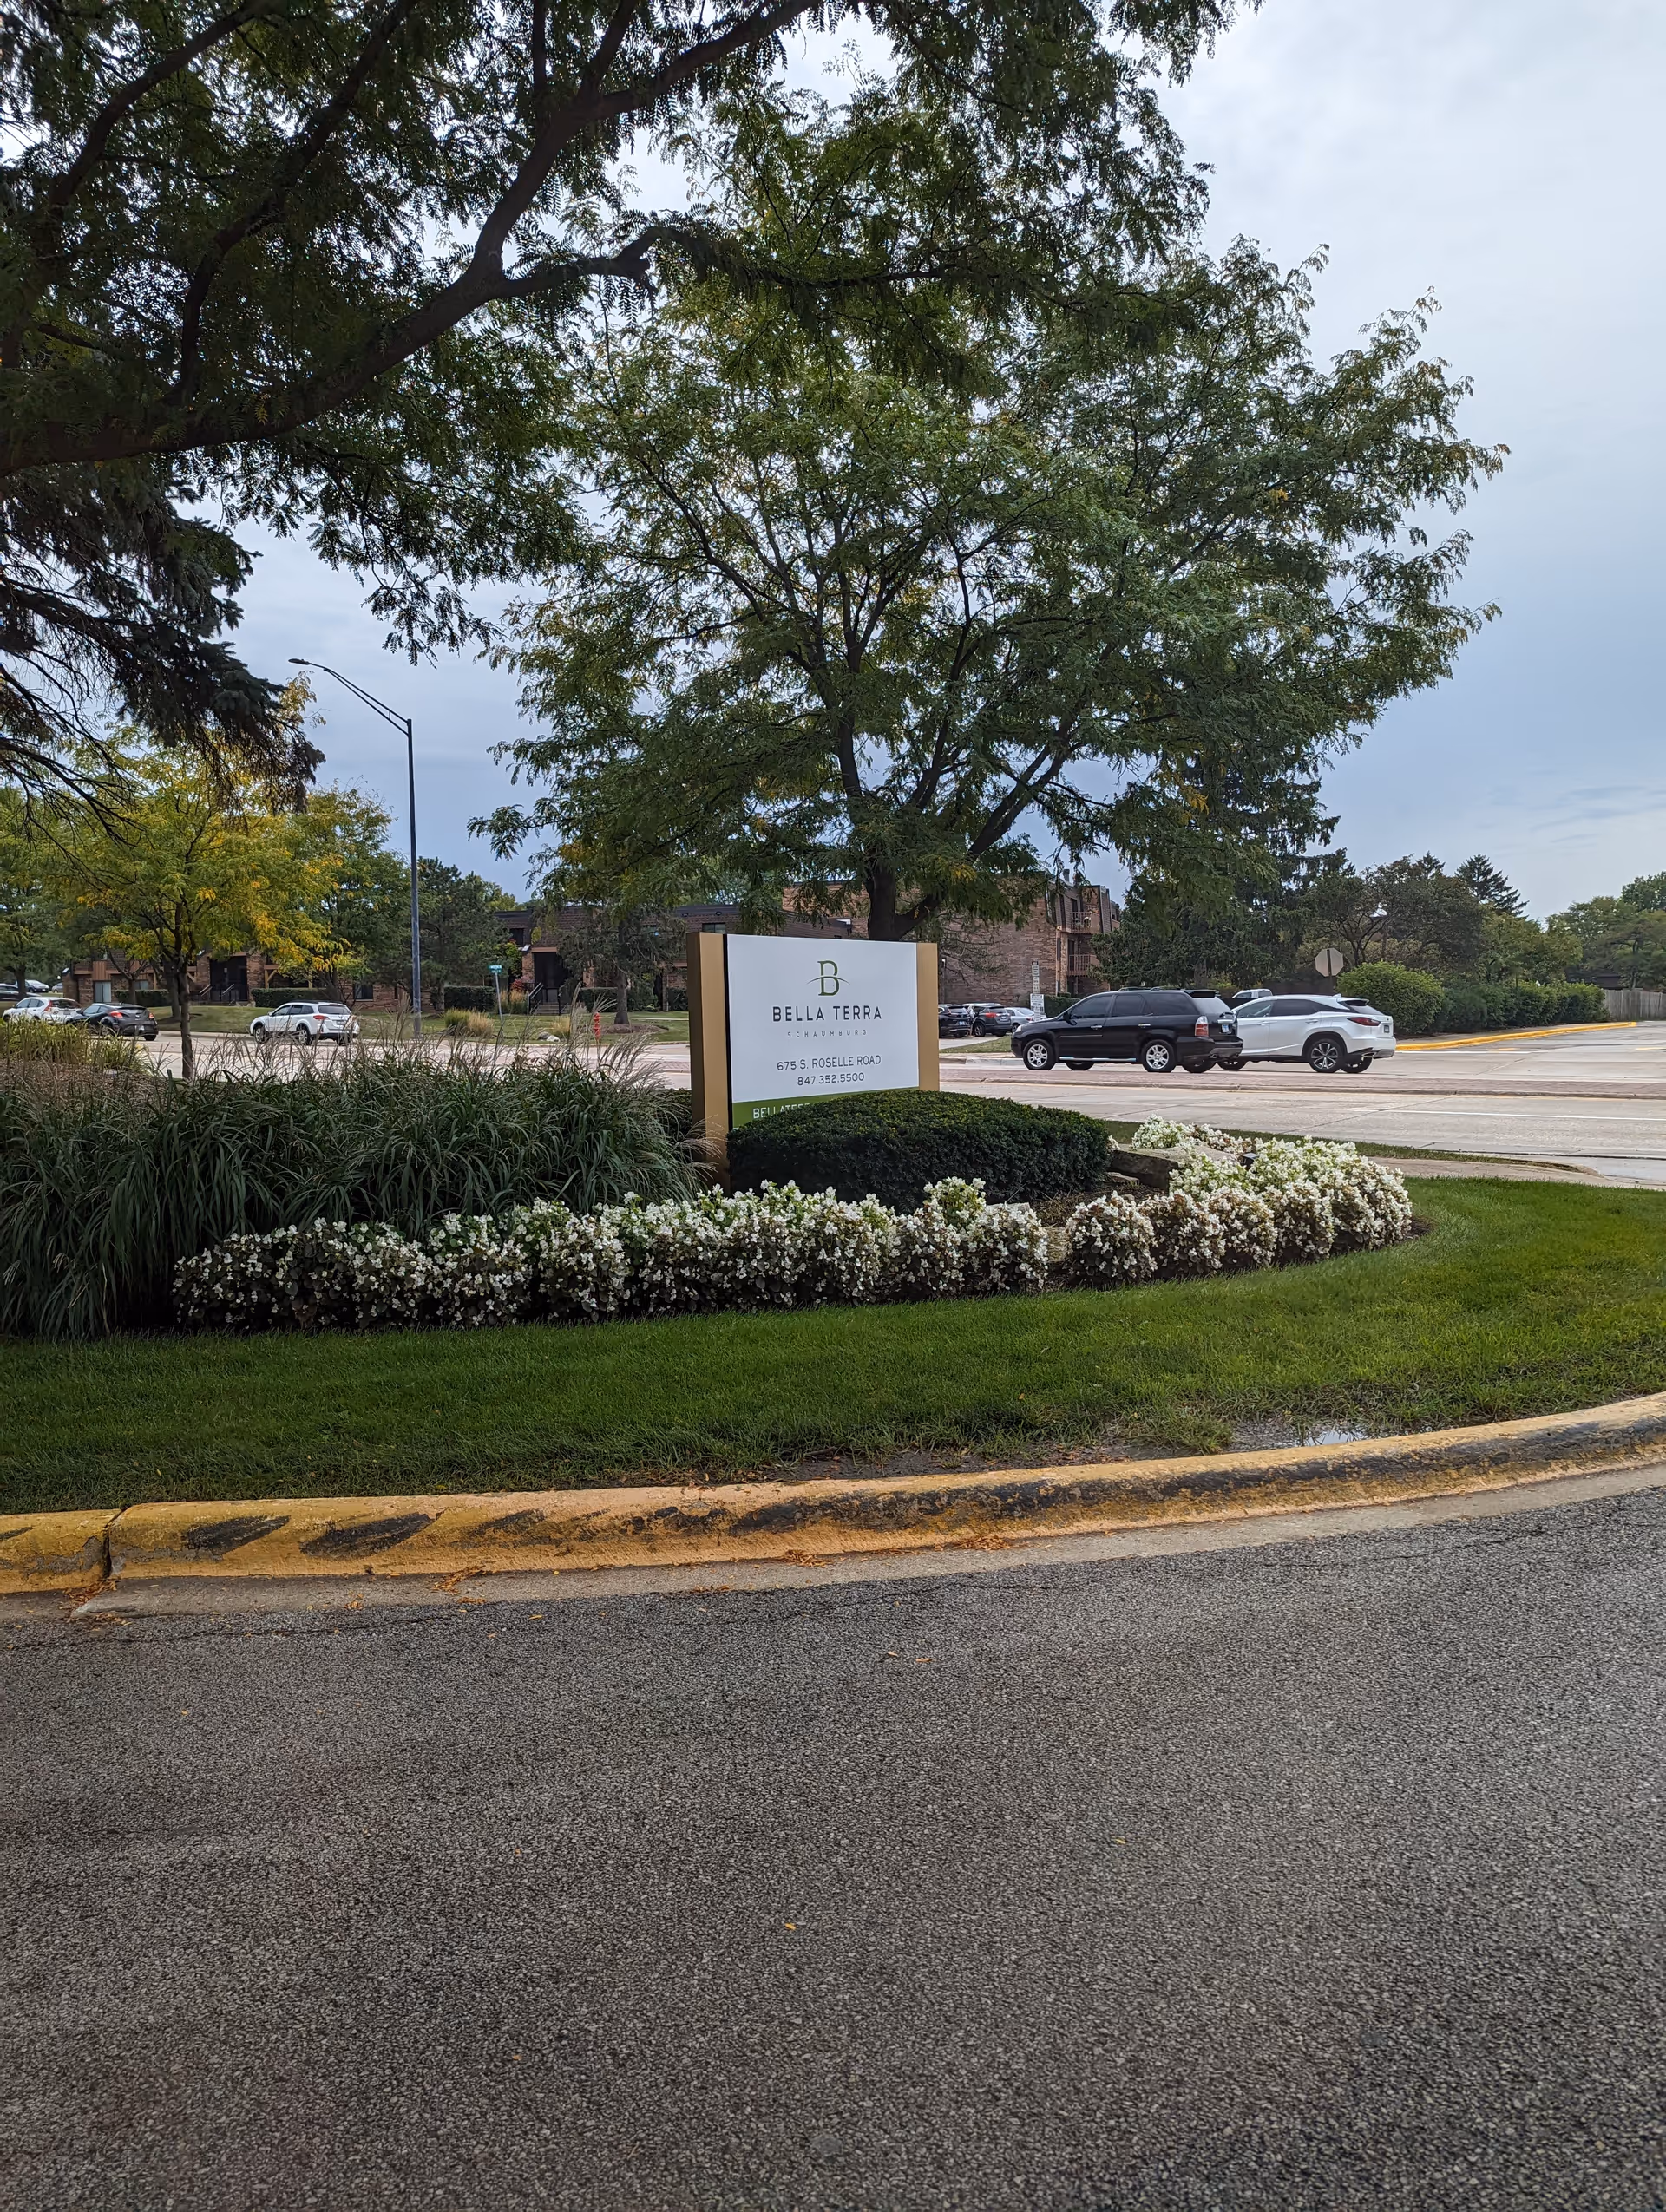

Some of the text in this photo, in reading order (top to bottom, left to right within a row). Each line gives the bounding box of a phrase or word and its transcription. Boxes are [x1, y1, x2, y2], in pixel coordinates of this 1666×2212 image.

[817, 960, 840, 996] B
[772, 1005, 882, 1022] BELLA TERRA
[787, 1029, 867, 1038] SCHAUMBURG
[777, 1055, 882, 1071] 675 S. ROSELLE ROAD
[797, 1072, 865, 1086] 847.352.5500
